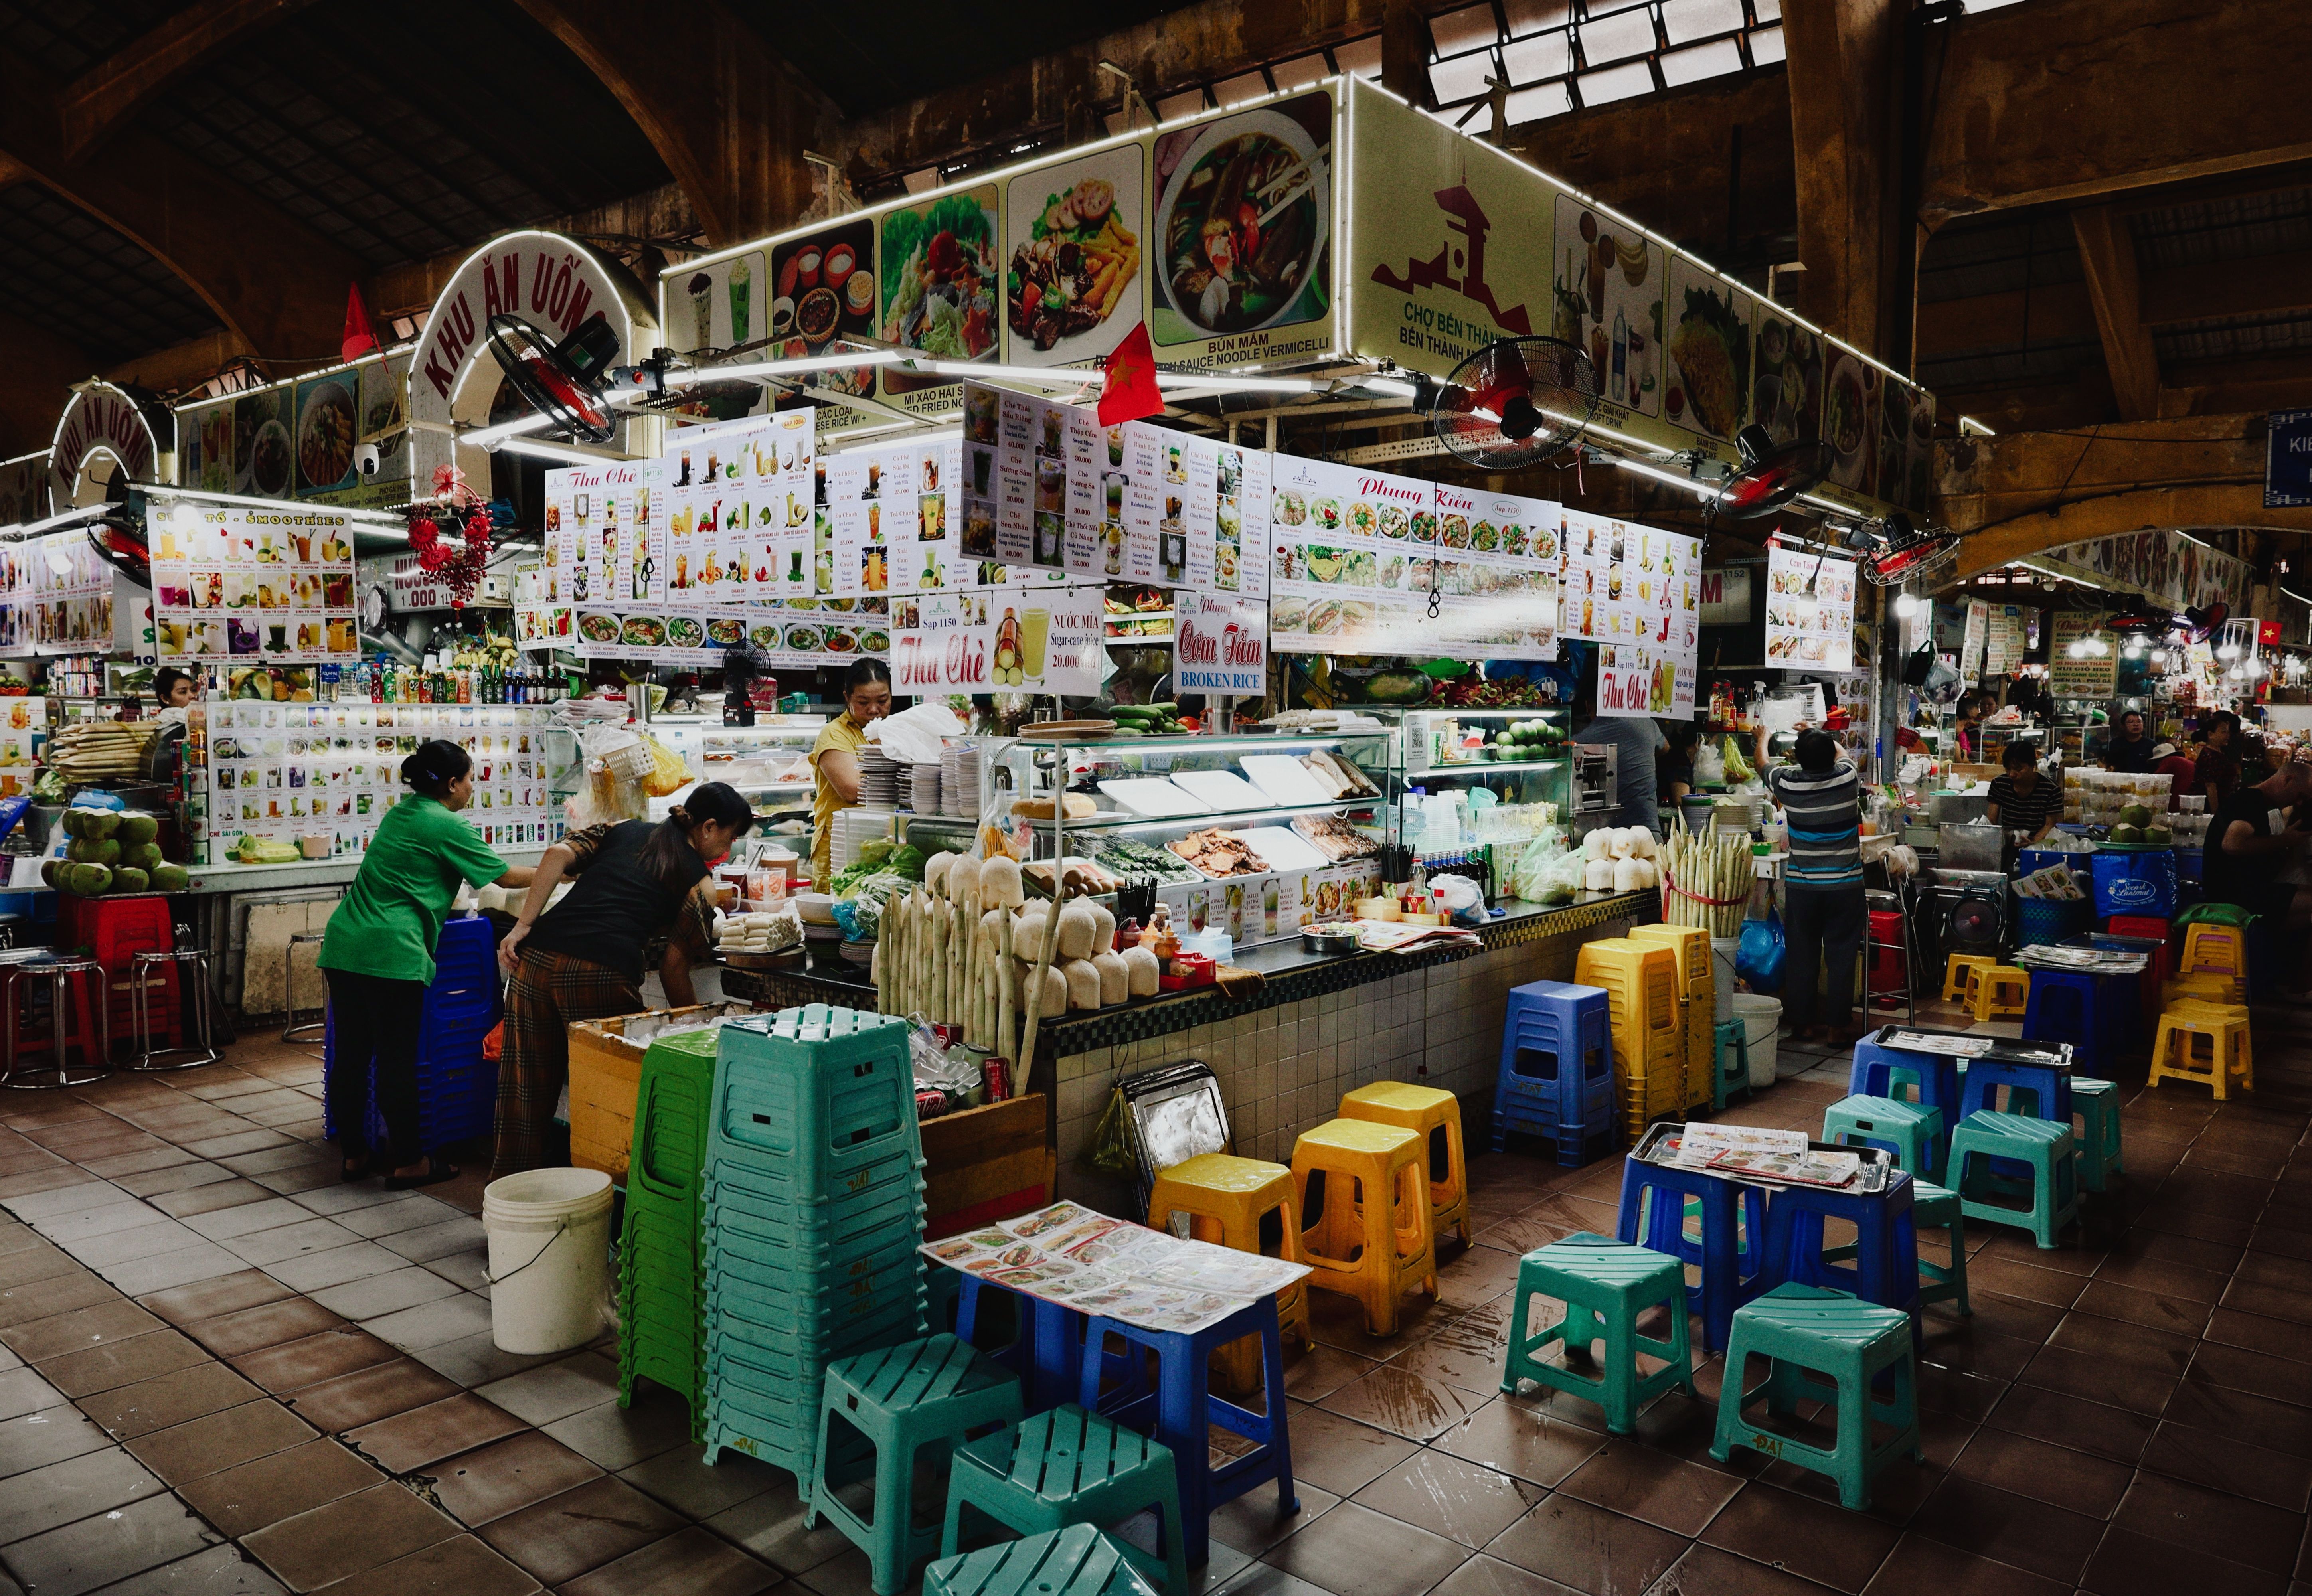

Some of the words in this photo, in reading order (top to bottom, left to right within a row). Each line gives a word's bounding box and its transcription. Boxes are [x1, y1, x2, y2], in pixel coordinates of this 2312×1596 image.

[424, 290, 475, 401] KHU
[482, 253, 519, 323] ĂN
[1405, 302, 1434, 332] CHỢ
[1437, 312, 1463, 338] BẾN
[1466, 322, 1507, 346] THÀN
[1208, 338, 1234, 353] BÚN
[1239, 334, 1269, 348] MẮM
[1217, 348, 1260, 365] NOODLE
[1263, 338, 1329, 358] VERMICELLI
[1400, 326, 1423, 349] BẾN
[1426, 335, 1464, 361] THÀNH
[904, 393, 914, 405] MÌ
[917, 391, 937, 403] XÀO
[939, 387, 956, 398] HẢI
[817, 407, 832, 420] CÁC
[921, 401, 949, 413] FRIED
[832, 418, 849, 428] RICE
[851, 415, 860, 425] W/
[58, 420, 82, 492] KHU
[83, 395, 103, 443] ĂN
[1008, 442, 1025, 450] 40.000
[1075, 455, 1091, 464] 30.000
[1007, 496, 1024, 504] 30.000
[1358, 476, 1423, 505] Phụng
[1432, 488, 1473, 510] Kiều
[246, 513, 344, 525] SMOOTHIES
[517, 563, 539, 573] SINH
[1201, 598, 1231, 616] Phụng
[923, 619, 938, 630] Sạp
[940, 618, 956, 628] 1150
[1054, 611, 1080, 629] NƯỚC
[1082, 611, 1099, 629] MÍA
[1051, 633, 1083, 649] Sugar-cane
[1084, 634, 1099, 649] juice
[1180, 619, 1217, 663] Cơm
[1223, 622, 1262, 665] Tấm
[899, 636, 940, 685] Thu
[946, 634, 986, 685] Chè
[1181, 671, 1229, 687] BROKEN
[1233, 674, 1260, 688] RICE
[1603, 672, 1624, 710] Thu
[1627, 674, 1647, 710] Chè
